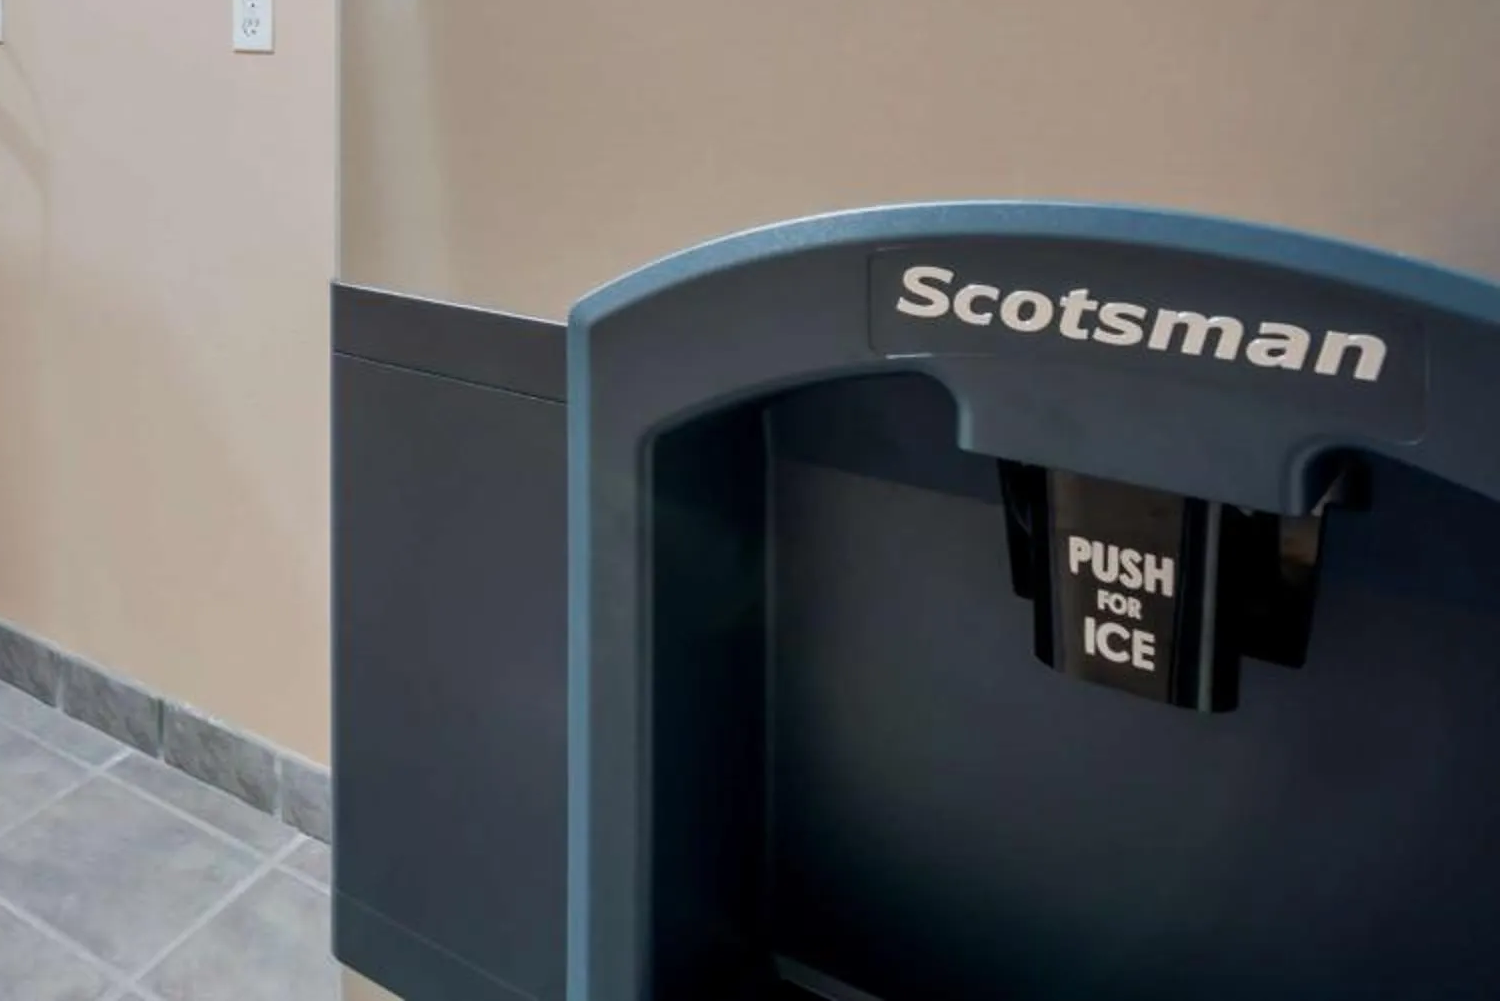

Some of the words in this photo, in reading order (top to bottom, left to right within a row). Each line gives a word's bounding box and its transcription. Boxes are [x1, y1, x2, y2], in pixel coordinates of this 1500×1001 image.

[897, 266, 1387, 381] Scotsman
[1069, 536, 1174, 597] PUSH
[1097, 589, 1142, 619] FOR
[1084, 616, 1155, 671] ICE
